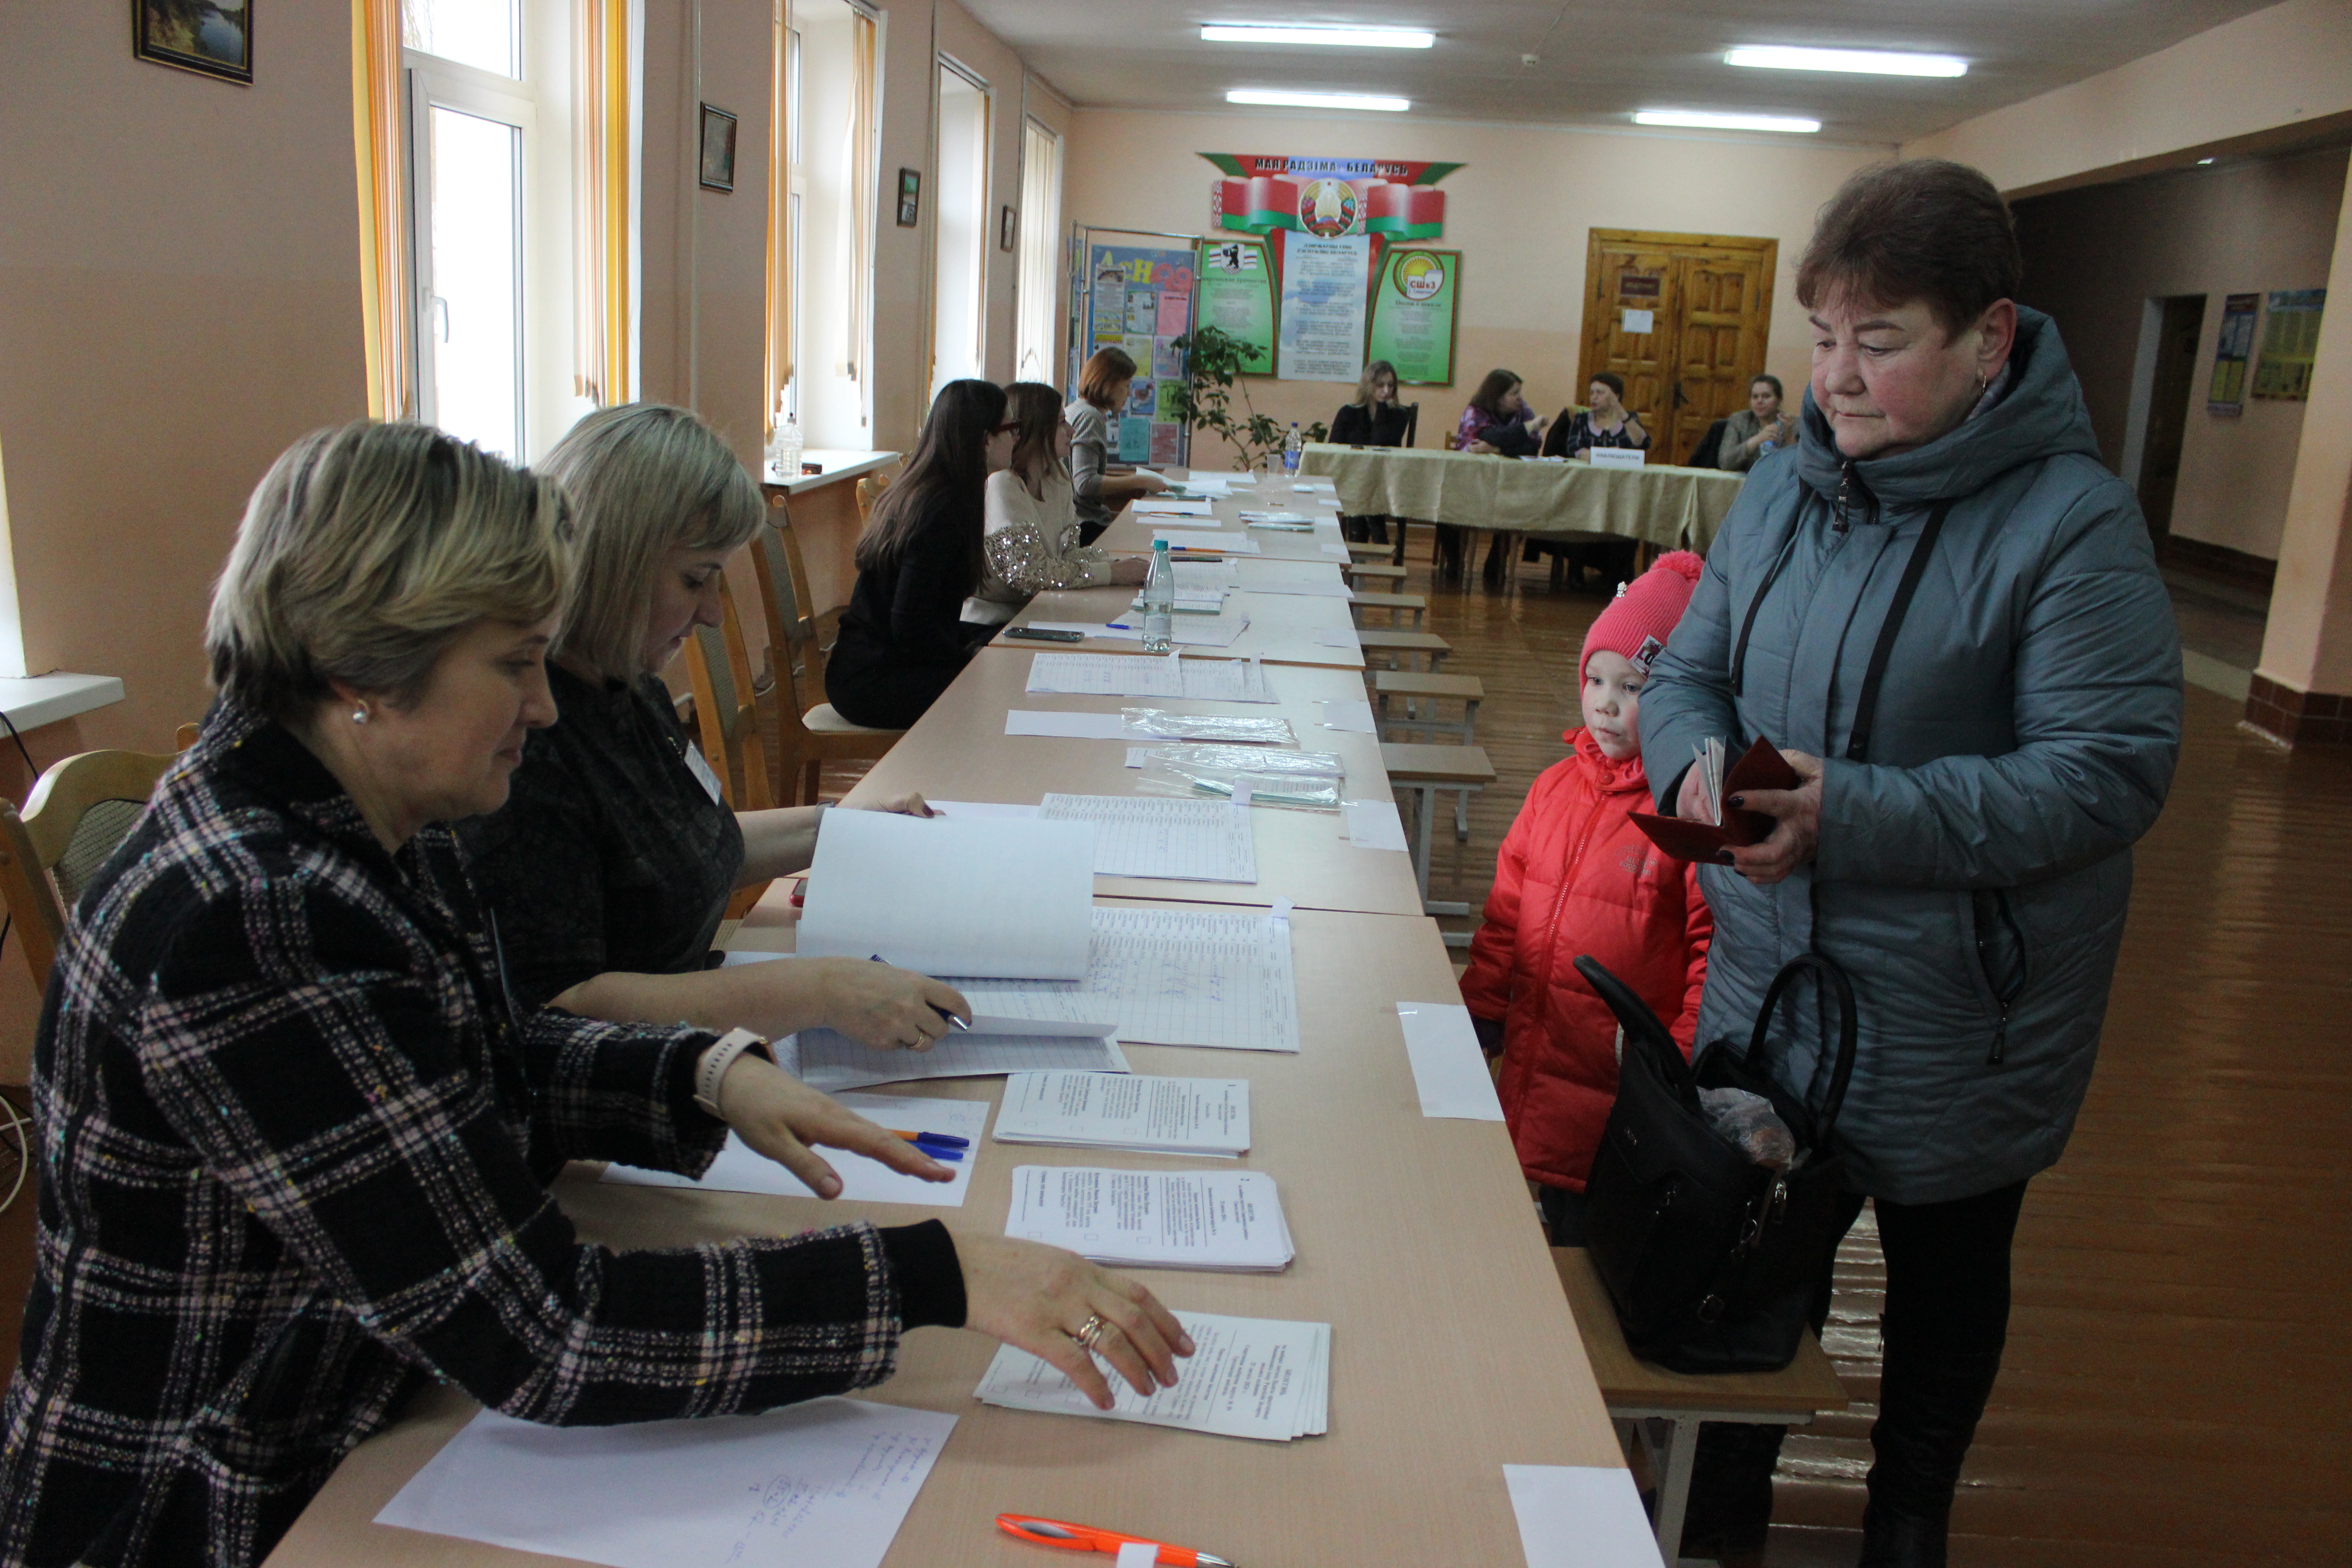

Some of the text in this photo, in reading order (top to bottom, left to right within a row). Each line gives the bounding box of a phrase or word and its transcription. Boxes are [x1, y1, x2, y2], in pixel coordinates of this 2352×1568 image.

[1255, 158, 1280, 170] МАЯ
[1283, 160, 1338, 172] РАДЗІМА
[1346, 162, 1408, 176] БЕЛАРУСЬ
